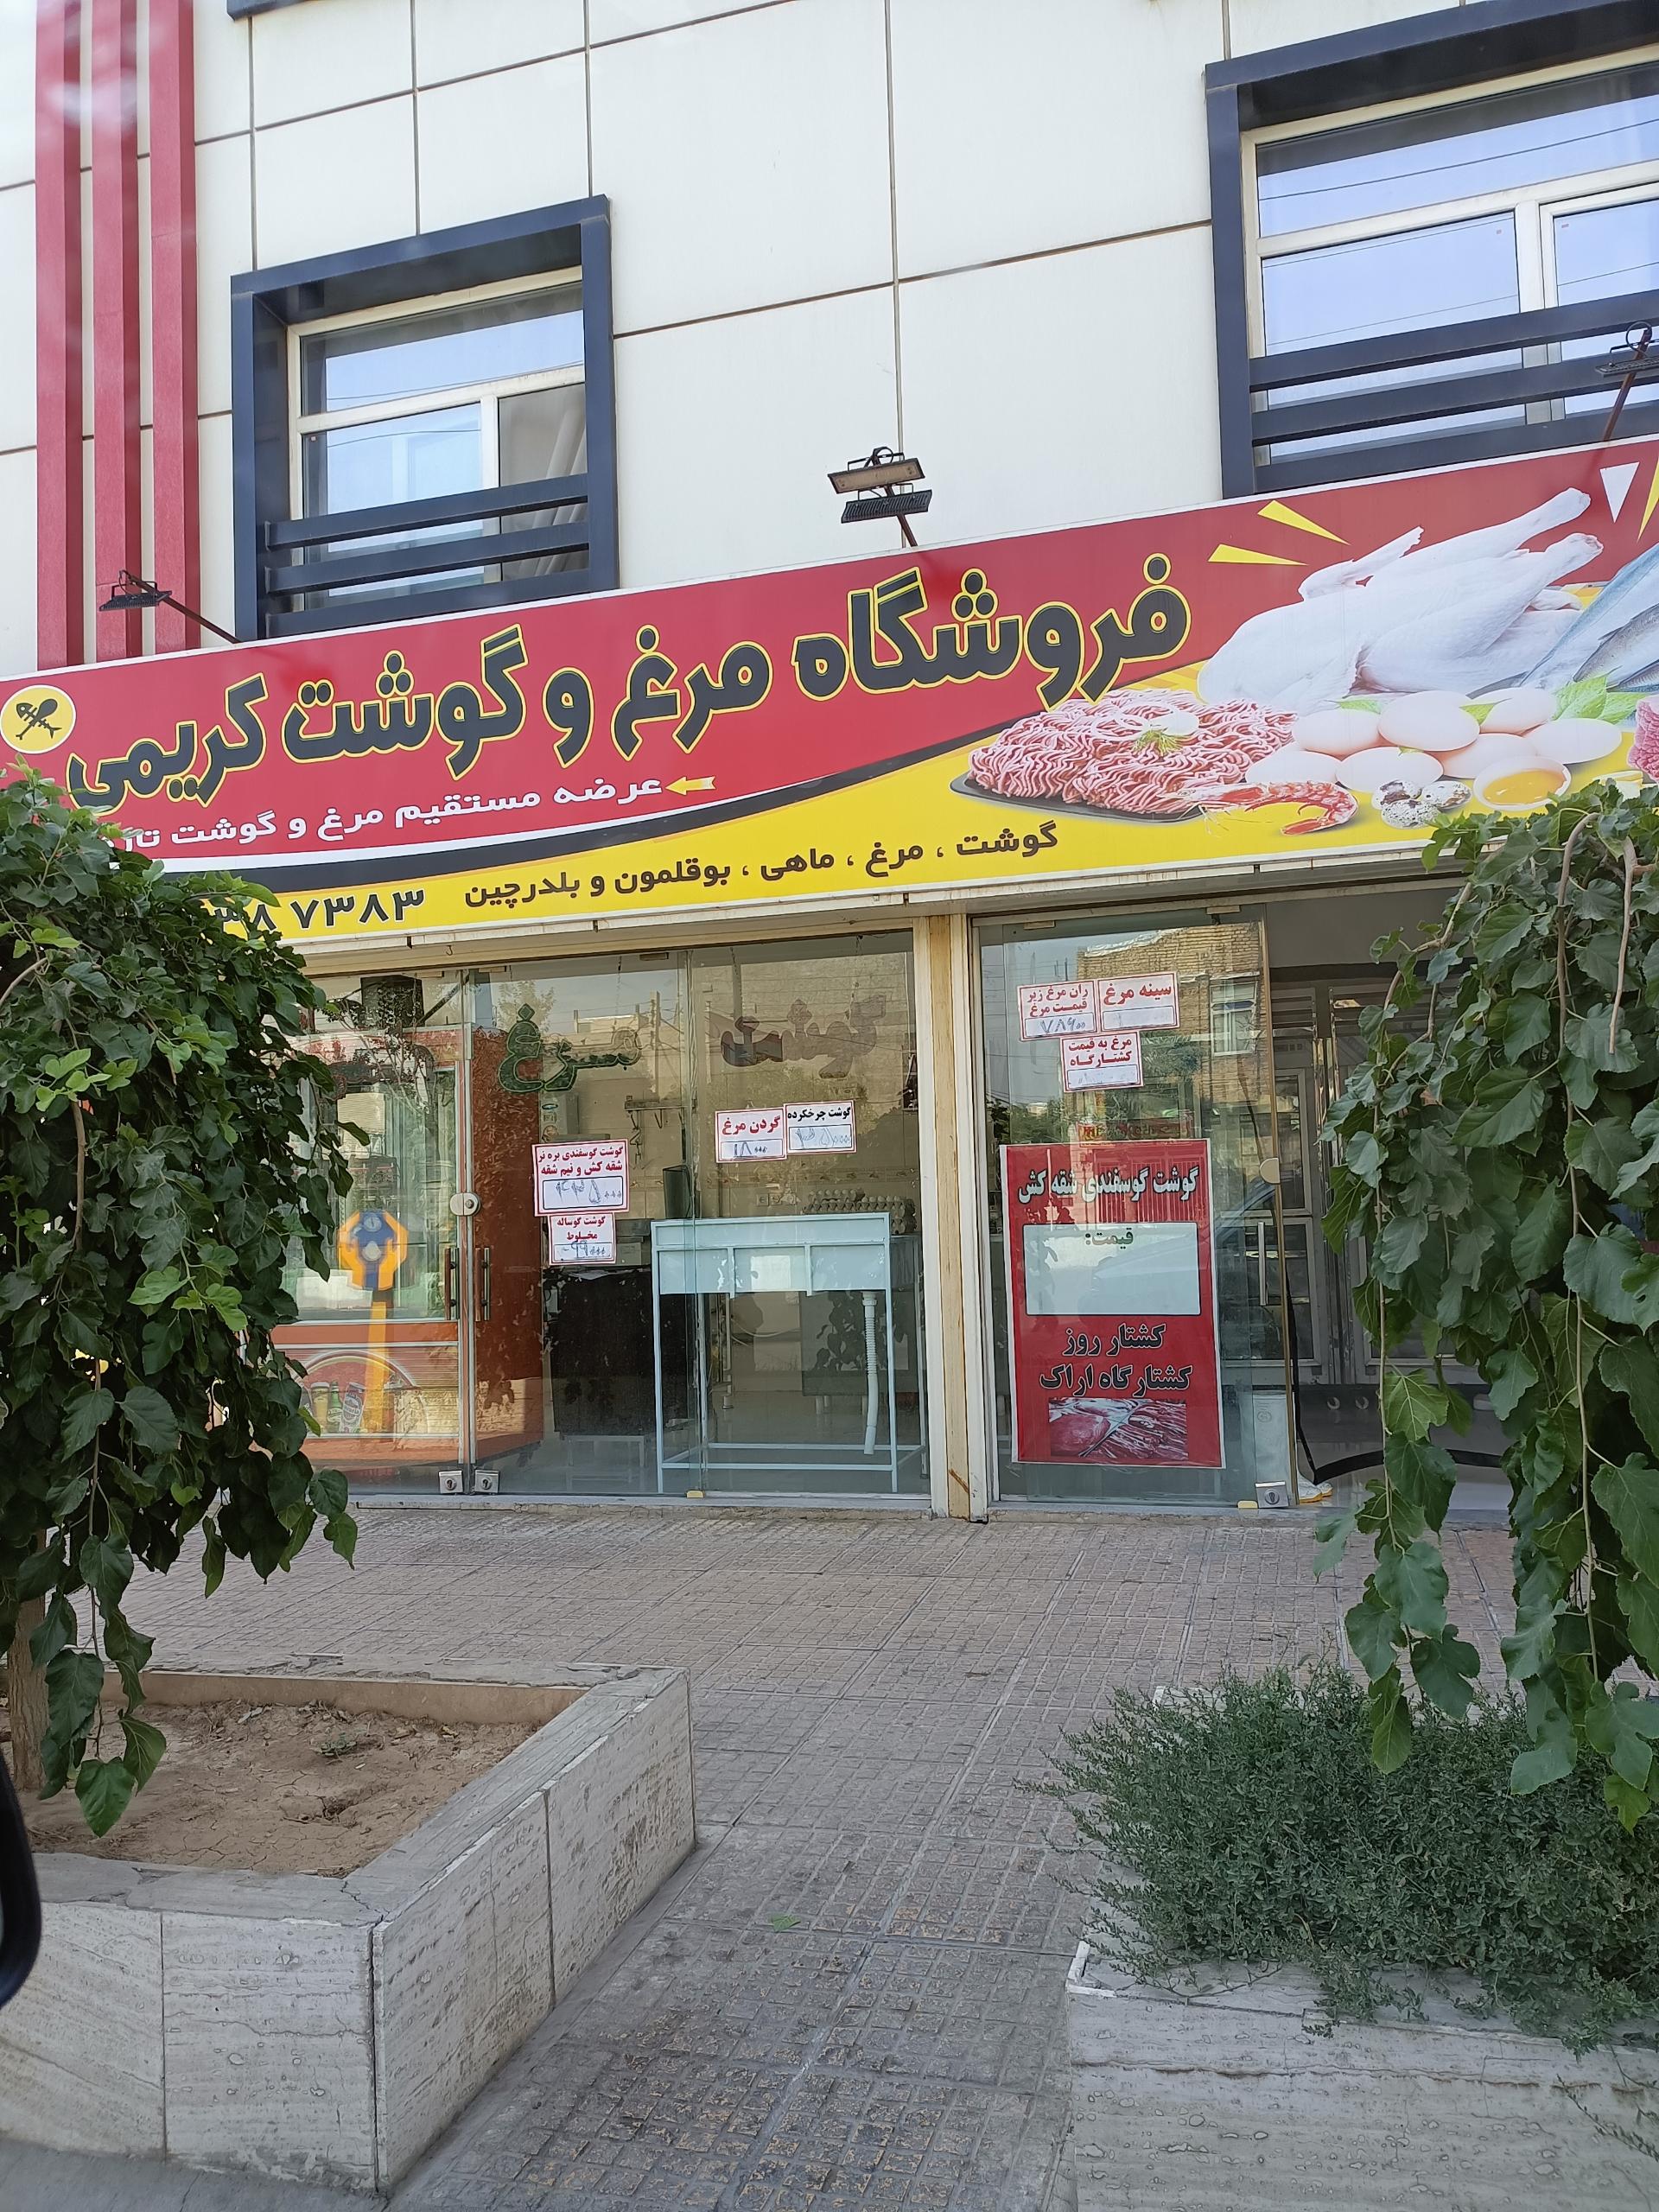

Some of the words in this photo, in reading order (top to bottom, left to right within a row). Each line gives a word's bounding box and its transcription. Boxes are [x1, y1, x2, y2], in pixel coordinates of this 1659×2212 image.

[791, 553, 1192, 711] فروشگاه
[282, 624, 528, 780] گوشت
[611, 625, 773, 760] مرغ
[543, 667, 594, 767] و
[66, 673, 269, 817] کریمی
[553, 778, 663, 805] عرضه
[317, 807, 384, 842] مرغ
[395, 791, 541, 828] مستقیم
[170, 810, 277, 844] گوشت
[288, 817, 307, 840] و
[957, 820, 1058, 858] گوشت
[760, 849, 836, 881] ماهی
[865, 841, 924, 878] مرغ
[465, 872, 581, 909] بلدرچین
[590, 874, 606, 897] و
[614, 858, 732, 895] بوقلمون
[290, 889, 425, 930] ۷۳۸۳
[1046, 985, 1066, 1001] مرغ
[1052, 998, 1088, 1013] قیمت
[1103, 982, 1135, 1006] مرغ
[1139, 982, 1173, 1001] سینه
[1029, 1002, 1051, 1017] مرغ
[498, 1002, 643, 1093] مرغ
[1068, 1038, 1096, 1052] قیمت
[1097, 1039, 1108, 1052] به
[1110, 1035, 1132, 1051] مرغ
[721, 1117, 747, 1136] مرغ
[749, 1115, 781, 1134] گردن
[827, 1107, 851, 1120] گوشت
[562, 1147, 598, 1161] گوسفندی
[599, 1146, 624, 1157] گوشت
[575, 1166, 582, 1177] و
[1082, 1166, 1151, 1204] گوسفندی
[1153, 1166, 1200, 1202] گوشت
[556, 1217, 582, 1229] گوساله
[583, 1215, 607, 1228] گوشت
[1062, 1327, 1102, 1357] روز
[1106, 1323, 1166, 1357] کشتار
[1039, 1363, 1094, 1397] اراک
